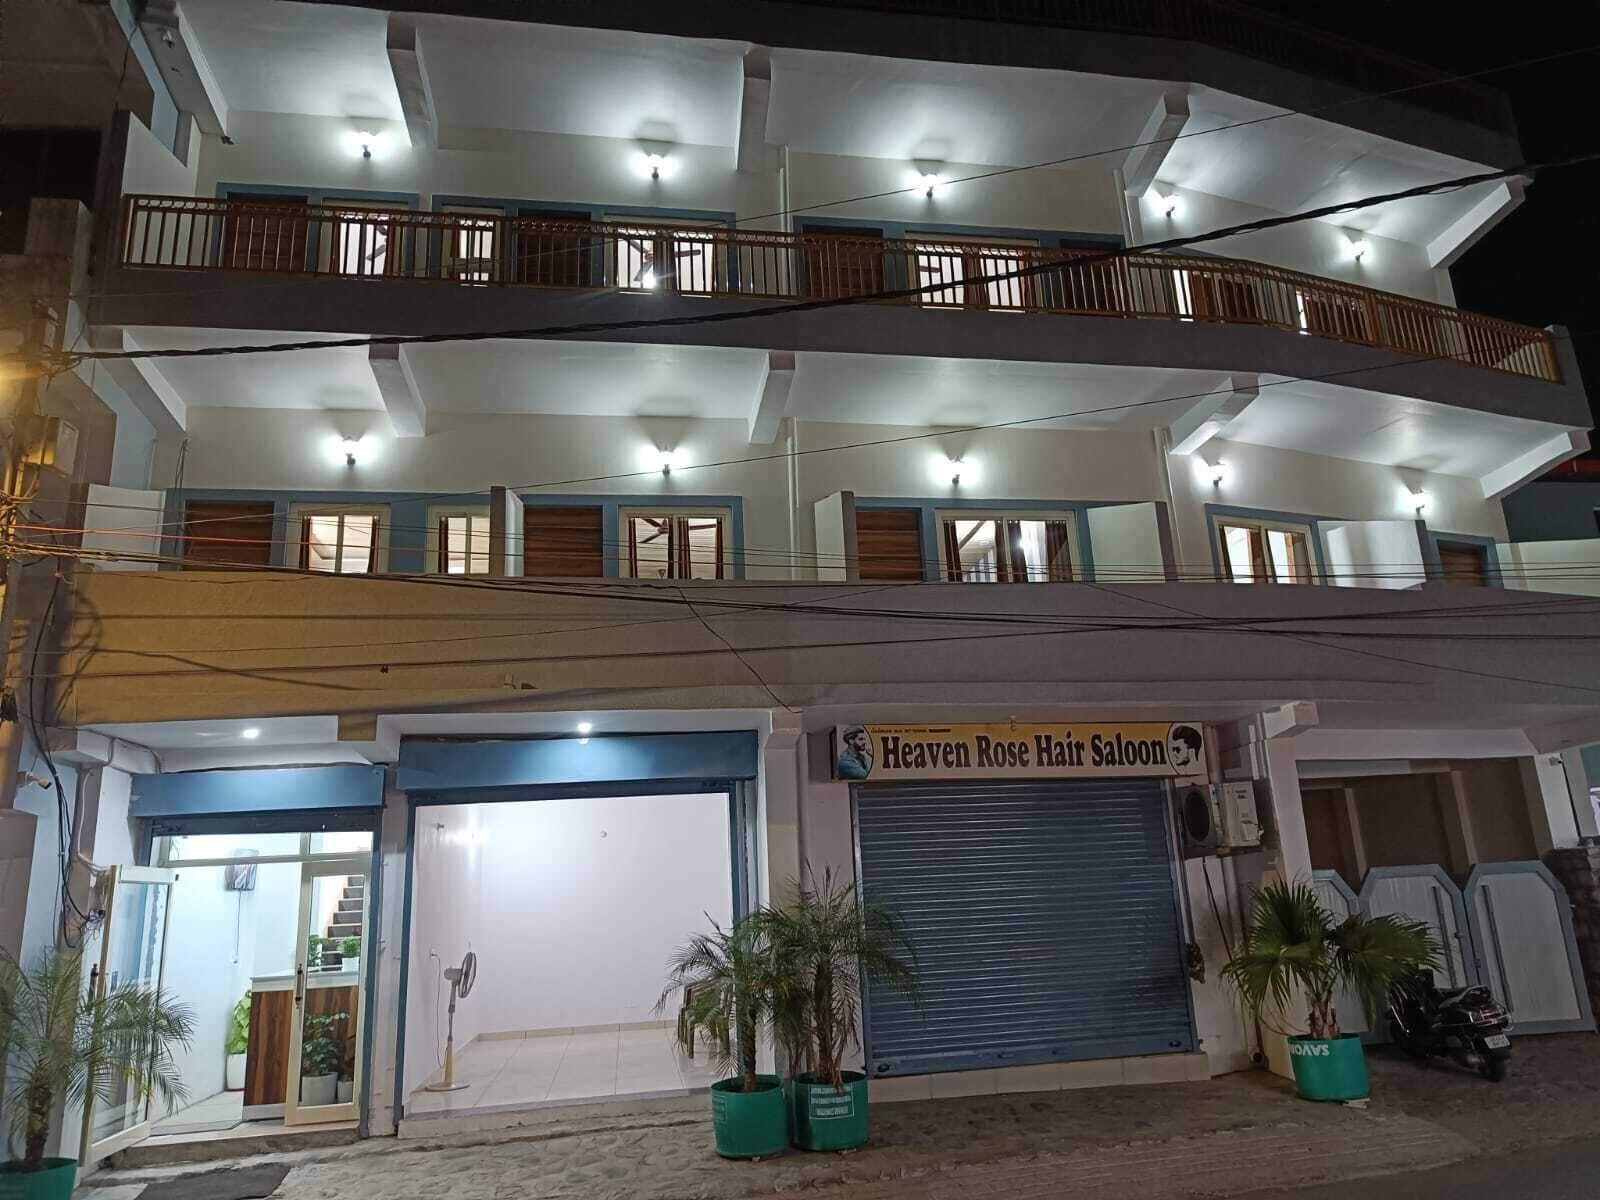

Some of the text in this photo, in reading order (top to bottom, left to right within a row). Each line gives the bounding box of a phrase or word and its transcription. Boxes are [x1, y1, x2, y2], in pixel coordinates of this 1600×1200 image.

[881, 730, 1167, 769] Heaven Rose Hair Saloon
